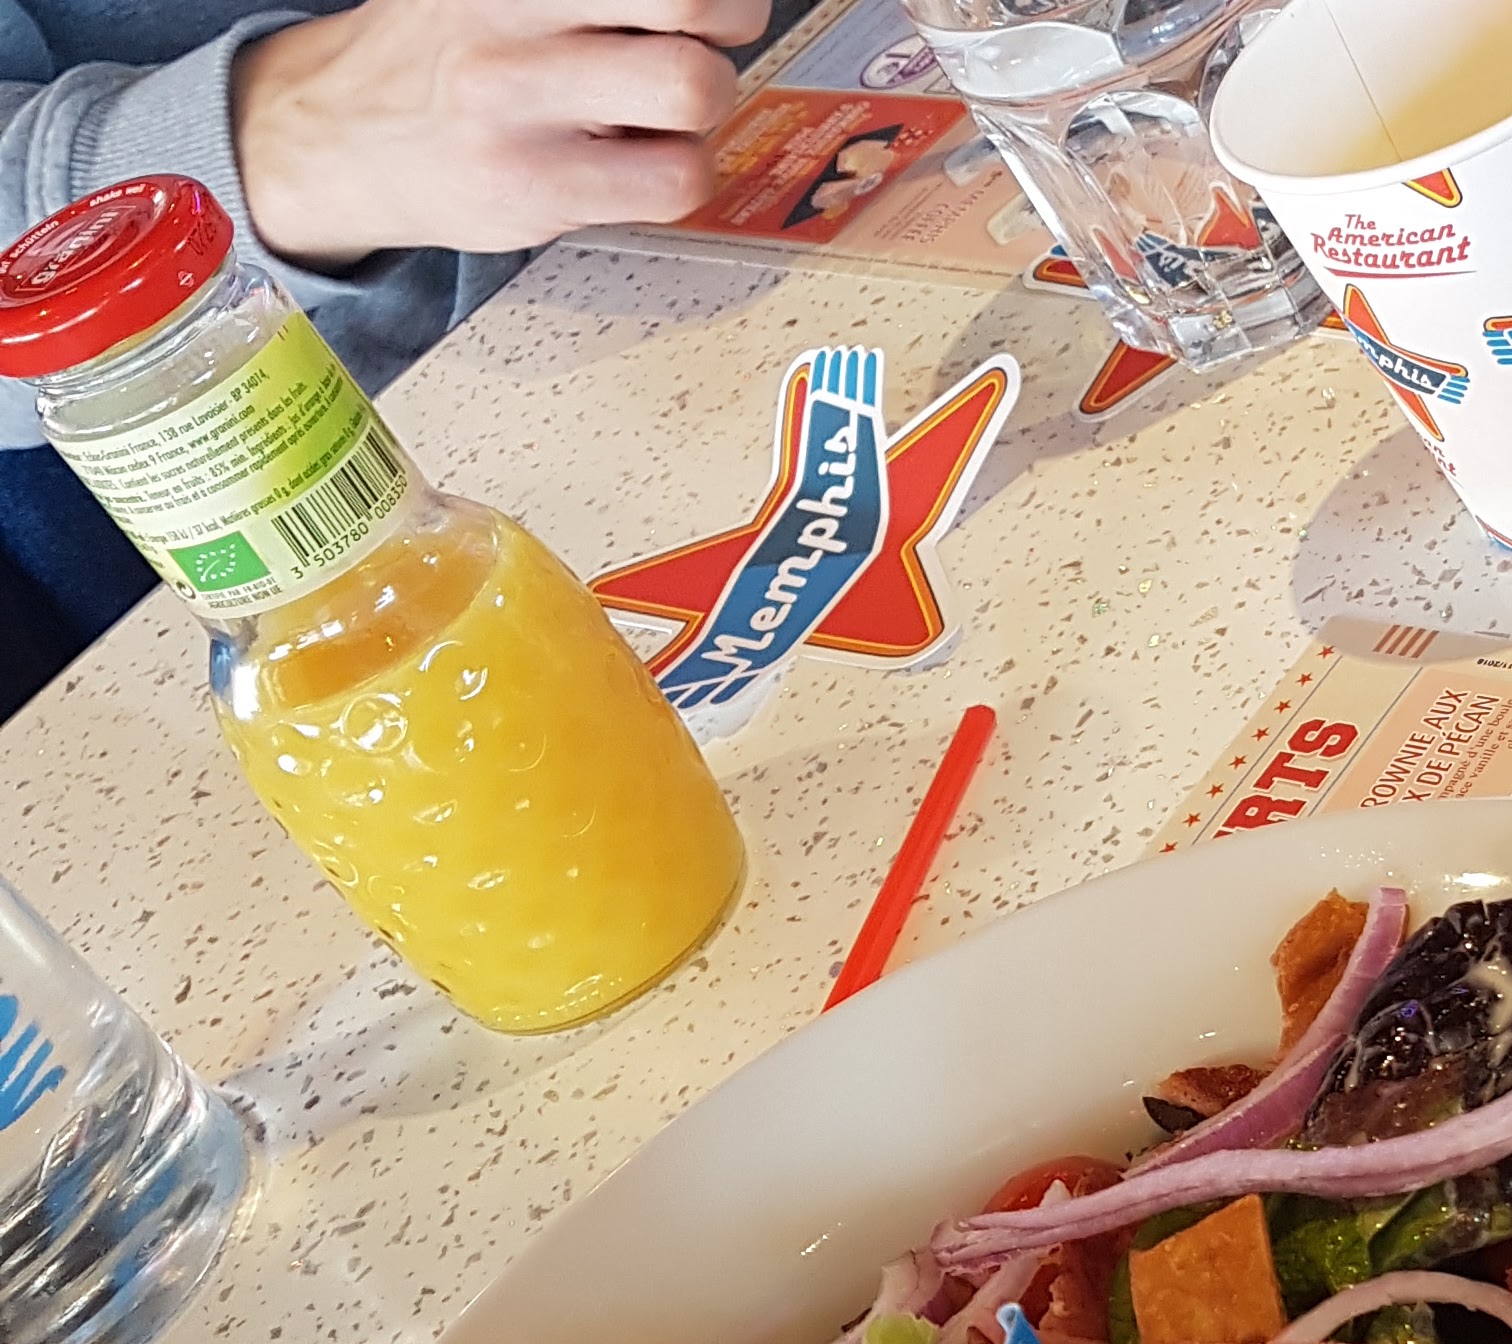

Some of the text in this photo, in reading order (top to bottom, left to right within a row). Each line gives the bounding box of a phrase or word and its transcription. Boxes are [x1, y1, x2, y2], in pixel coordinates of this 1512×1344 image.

[89, 187, 123, 207] shake
[9, 220, 60, 258] schütteln
[1327, 220, 1457, 248] American
[1344, 213, 1377, 230] The
[31, 210, 119, 285] granini
[1311, 231, 1472, 270] Restaurant
[159, 368, 271, 444] 138 rue Lavoisier BP 34014,
[155, 445, 190, 464] France,
[186, 402, 258, 454] www.granini.com
[184, 431, 239, 474] naturellement
[264, 400, 285, 420] dans
[291, 565, 305, 581] 3
[313, 521, 371, 568] 503780
[374, 475, 409, 520] 008350
[701, 425, 859, 674] Memphis
[1475, 657, 1512, 669] 11/2018
[1419, 686, 1469, 730] AUX
[1428, 690, 1501, 758] PÉCAN
[1414, 757, 1454, 787] DE
